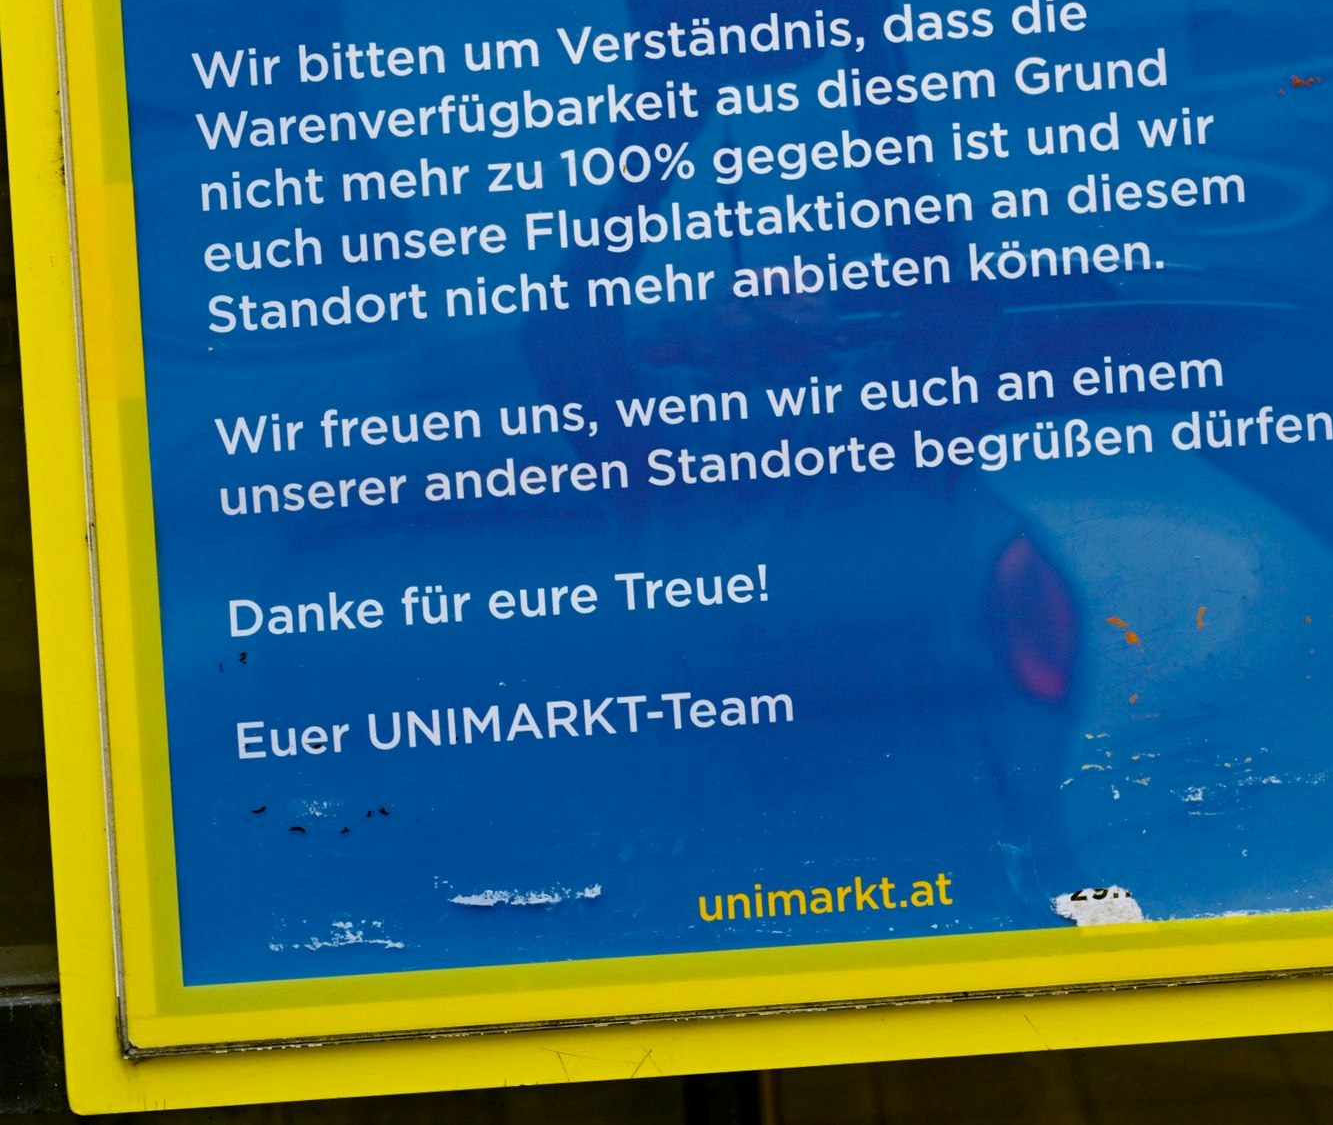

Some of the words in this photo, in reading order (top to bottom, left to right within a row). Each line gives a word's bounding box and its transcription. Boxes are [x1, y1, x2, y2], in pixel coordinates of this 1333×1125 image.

[192, 48, 280, 88] Wir
[299, 43, 445, 82] bitten
[465, 39, 539, 71] um
[557, 10, 864, 64] Verständnis,
[884, 4, 993, 43] dass
[196, 81, 698, 149] Warenverfügbarkeit
[717, 83, 799, 115] aus
[818, 69, 995, 108] diesem
[1015, 48, 1166, 94] Grund
[202, 168, 323, 211] nicht
[343, 159, 469, 201] mehr
[488, 161, 542, 191] zu
[561, 143, 694, 186] 100%
[714, 130, 933, 184] gegeben
[953, 123, 1008, 160] ist
[1028, 112, 1119, 155] und
[1138, 108, 1213, 147] wir
[205, 228, 321, 271] euch
[343, 225, 506, 262] unsere
[526, 192, 972, 252] Flugblattaktionen
[992, 188, 1048, 218] an
[1068, 174, 1244, 213] diesem
[209, 285, 427, 332] Standort
[447, 274, 568, 316] nicht
[589, 264, 714, 307] mehr
[733, 253, 949, 297] anbieten
[969, 241, 1163, 281] können.
[215, 414, 303, 454] Wir
[321, 410, 480, 447] freuen
[501, 403, 597, 436] uns,
[616, 392, 747, 427] wenn
[767, 377, 842, 416] wir
[861, 367, 978, 410] euch
[998, 370, 1053, 401] an
[1074, 357, 1222, 395] einem
[221, 476, 406, 515] unserer
[426, 459, 628, 501] anderen
[648, 438, 895, 485] Standorte
[915, 419, 1152, 471] begrüßen
[230, 592, 383, 636] Danke
[402, 586, 470, 625] für
[489, 585, 597, 619] eure
[615, 565, 767, 610] Treue!
[237, 722, 349, 758] Euer
[369, 693, 793, 749] UNIMARKT-Team
[699, 874, 952, 921] unimarkt.at
